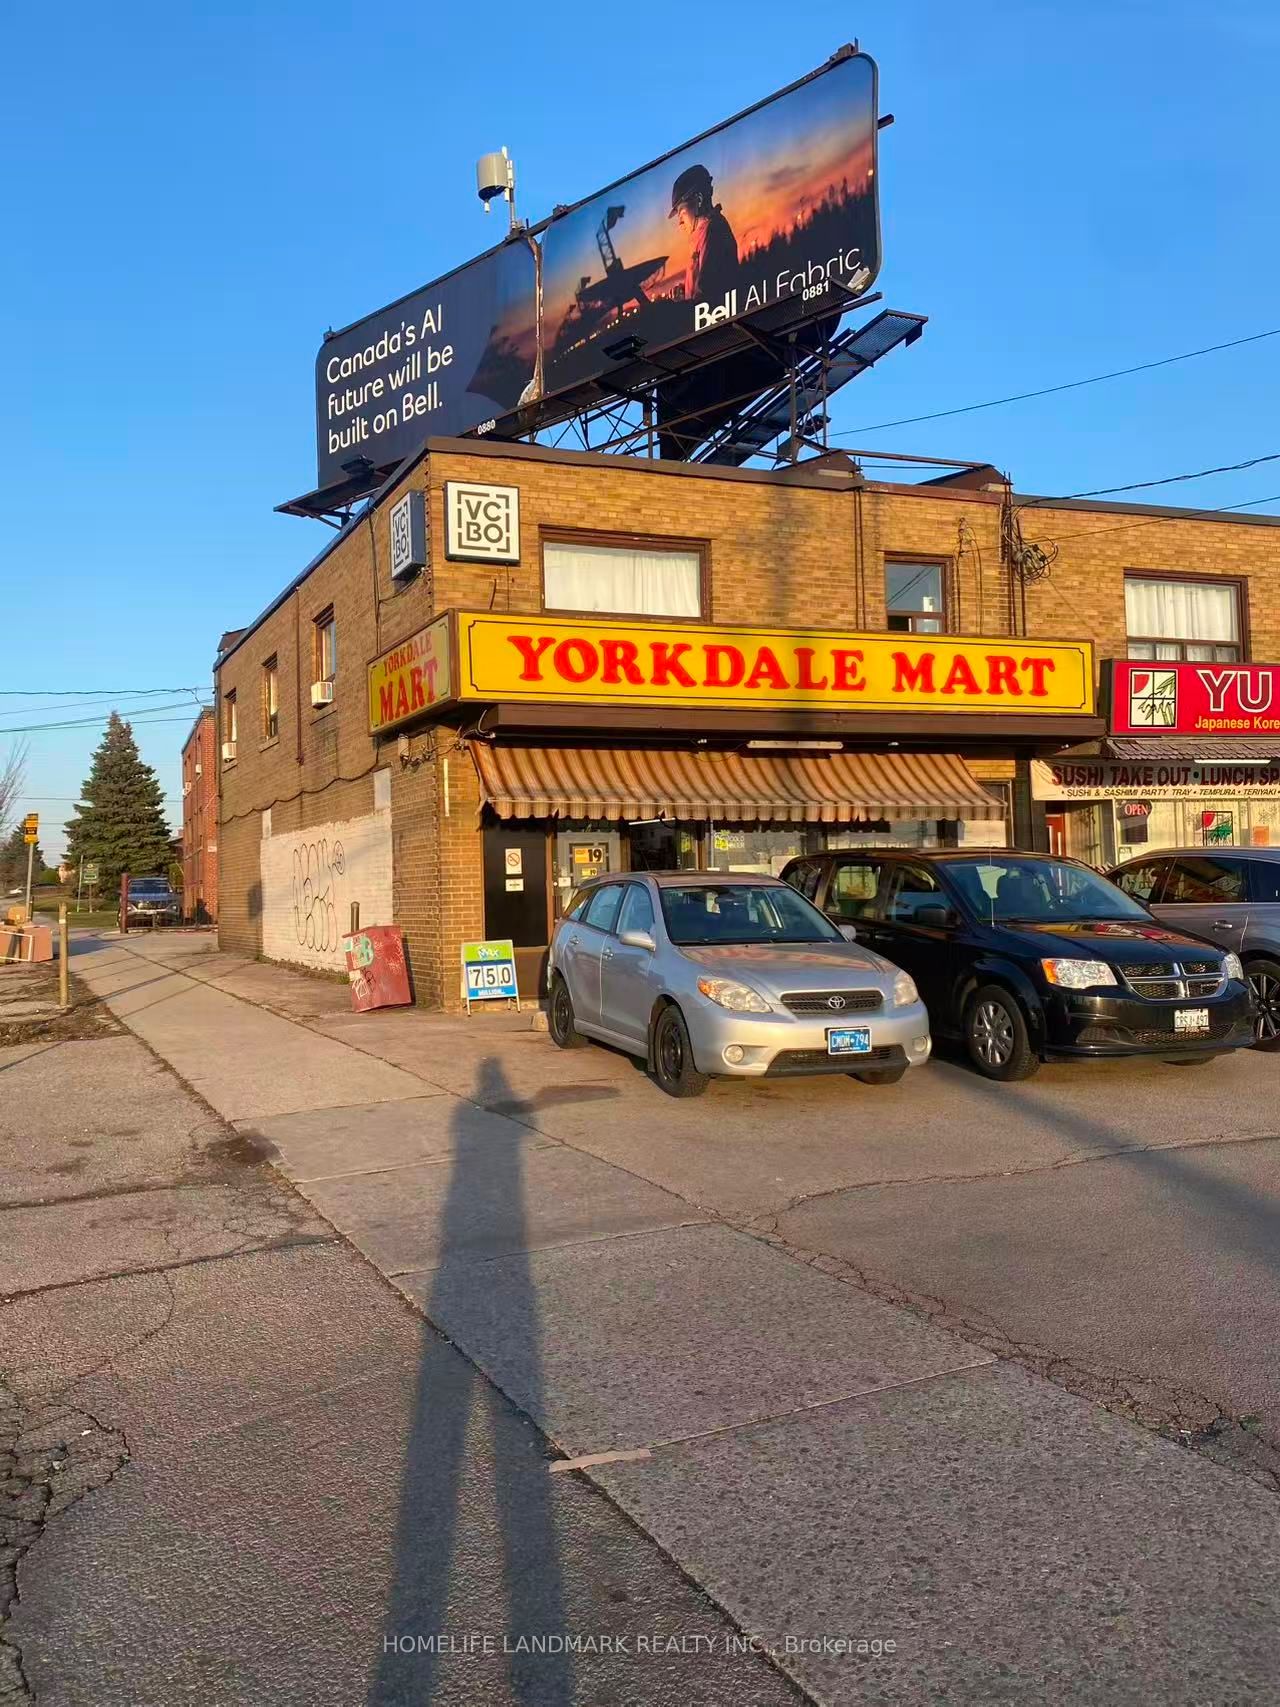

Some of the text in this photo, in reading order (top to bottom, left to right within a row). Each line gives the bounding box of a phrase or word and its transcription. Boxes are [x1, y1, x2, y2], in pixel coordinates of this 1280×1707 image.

[695, 248, 861, 331] Bell AI Fabric
[802, 280, 829, 301] 0881
[327, 304, 442, 383] Canada's AI
[328, 345, 453, 420] future will be
[328, 381, 443, 454] built on Bell.
[507, 635, 1056, 698] YORKDALE MART
[379, 656, 438, 725] MART
[1196, 669, 1273, 713] YU
[1195, 715, 1280, 731] Japanese Kore
[1052, 765, 1104, 786] SUSHI
[1110, 766, 1154, 786] TAKE
[1157, 766, 1191, 786] OUT
[1200, 767, 1255, 786] LUNCH
[1067, 788, 1277, 797] SUSHI & SASHIMI PARTY TRAY TEMPURA TERIYAKI
[1124, 803, 1148, 817] OPEN
[588, 848, 602, 862] 19
